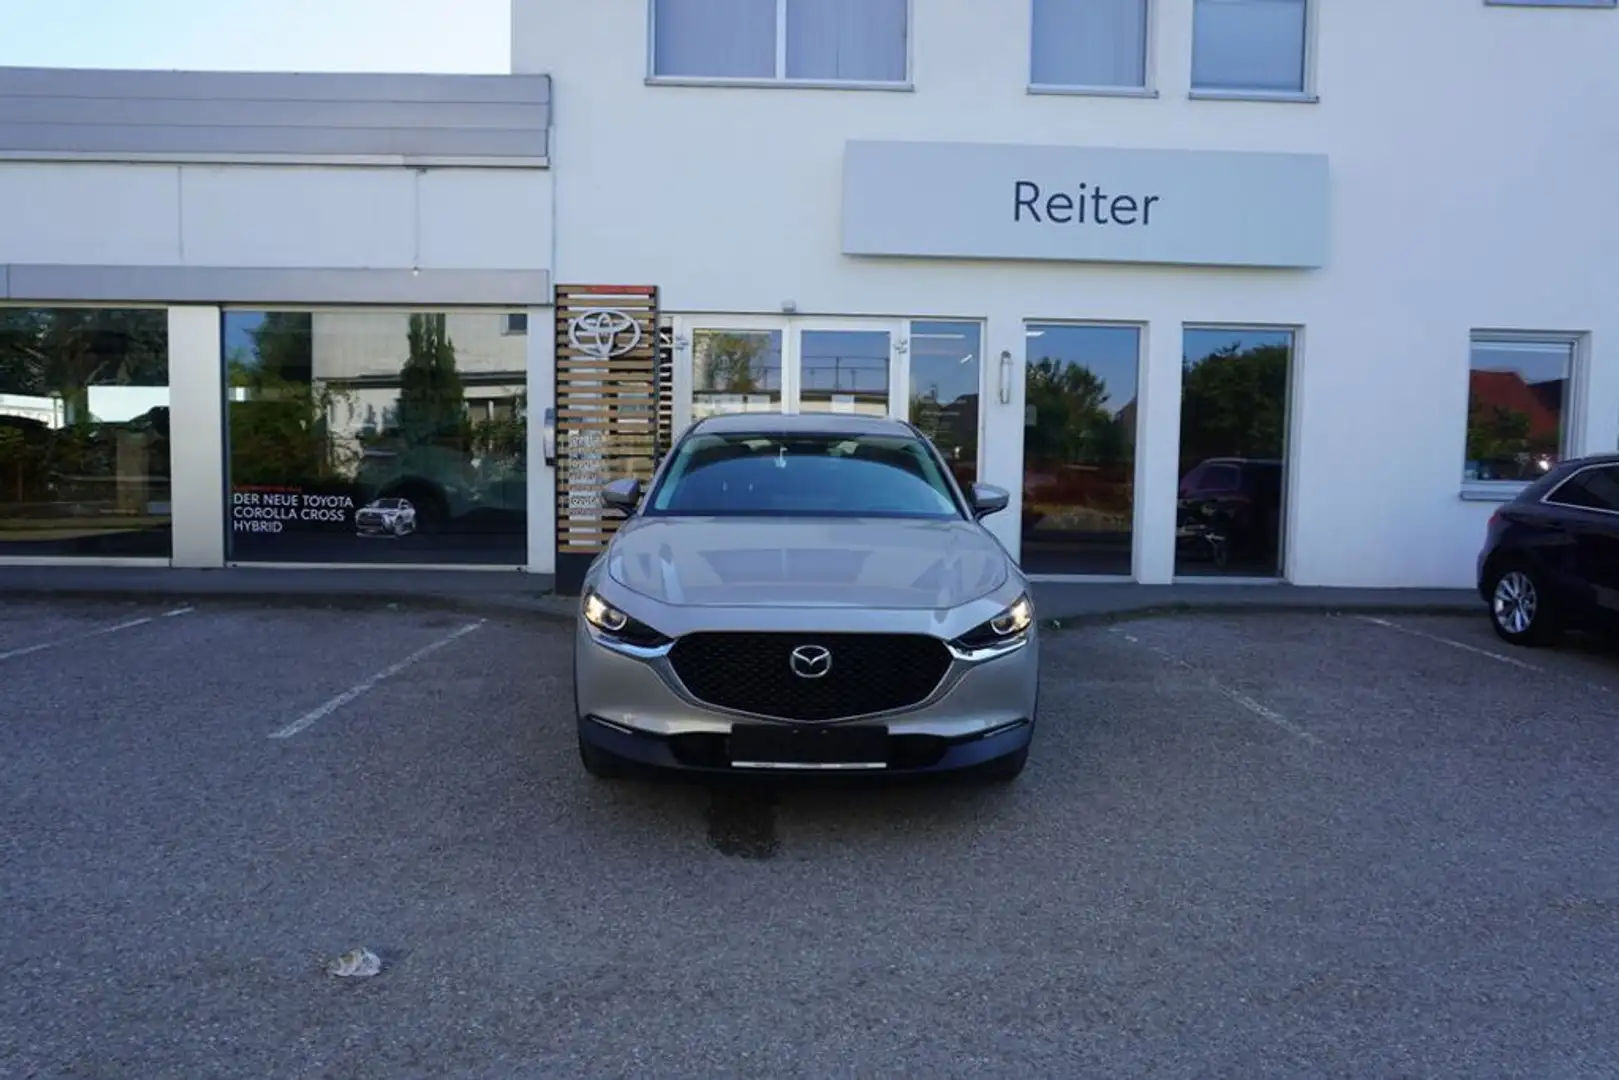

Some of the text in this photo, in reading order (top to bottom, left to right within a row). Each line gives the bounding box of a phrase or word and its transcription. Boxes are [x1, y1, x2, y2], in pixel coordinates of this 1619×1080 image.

[1014, 181, 1159, 225] Reiter
[233, 493, 354, 508] DER NEUE TOYOTA
[233, 507, 345, 521] COROLLA CROSS
[233, 521, 283, 533] HYBRID
